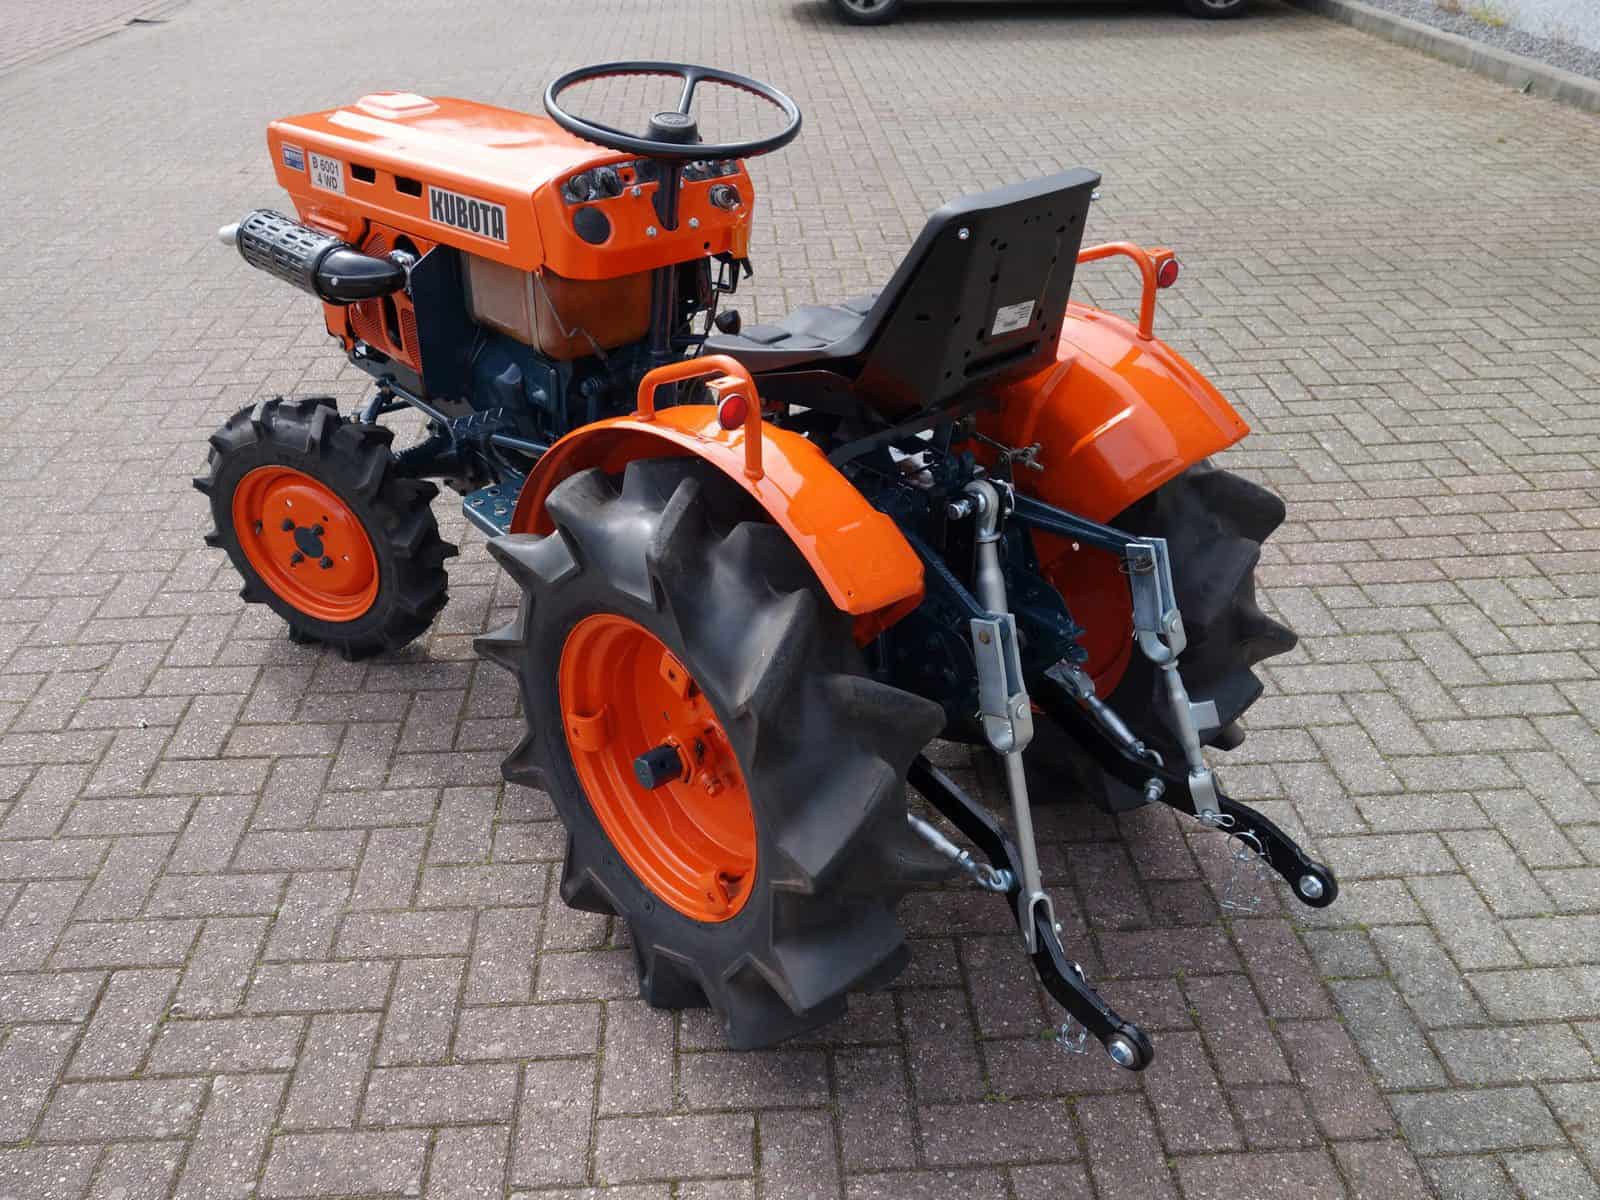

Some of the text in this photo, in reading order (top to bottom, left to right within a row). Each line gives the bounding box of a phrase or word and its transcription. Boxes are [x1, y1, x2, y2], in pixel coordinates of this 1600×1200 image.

[311, 155, 319, 168] B
[324, 172, 338, 189] WD
[430, 188, 505, 241] KUBOTA
